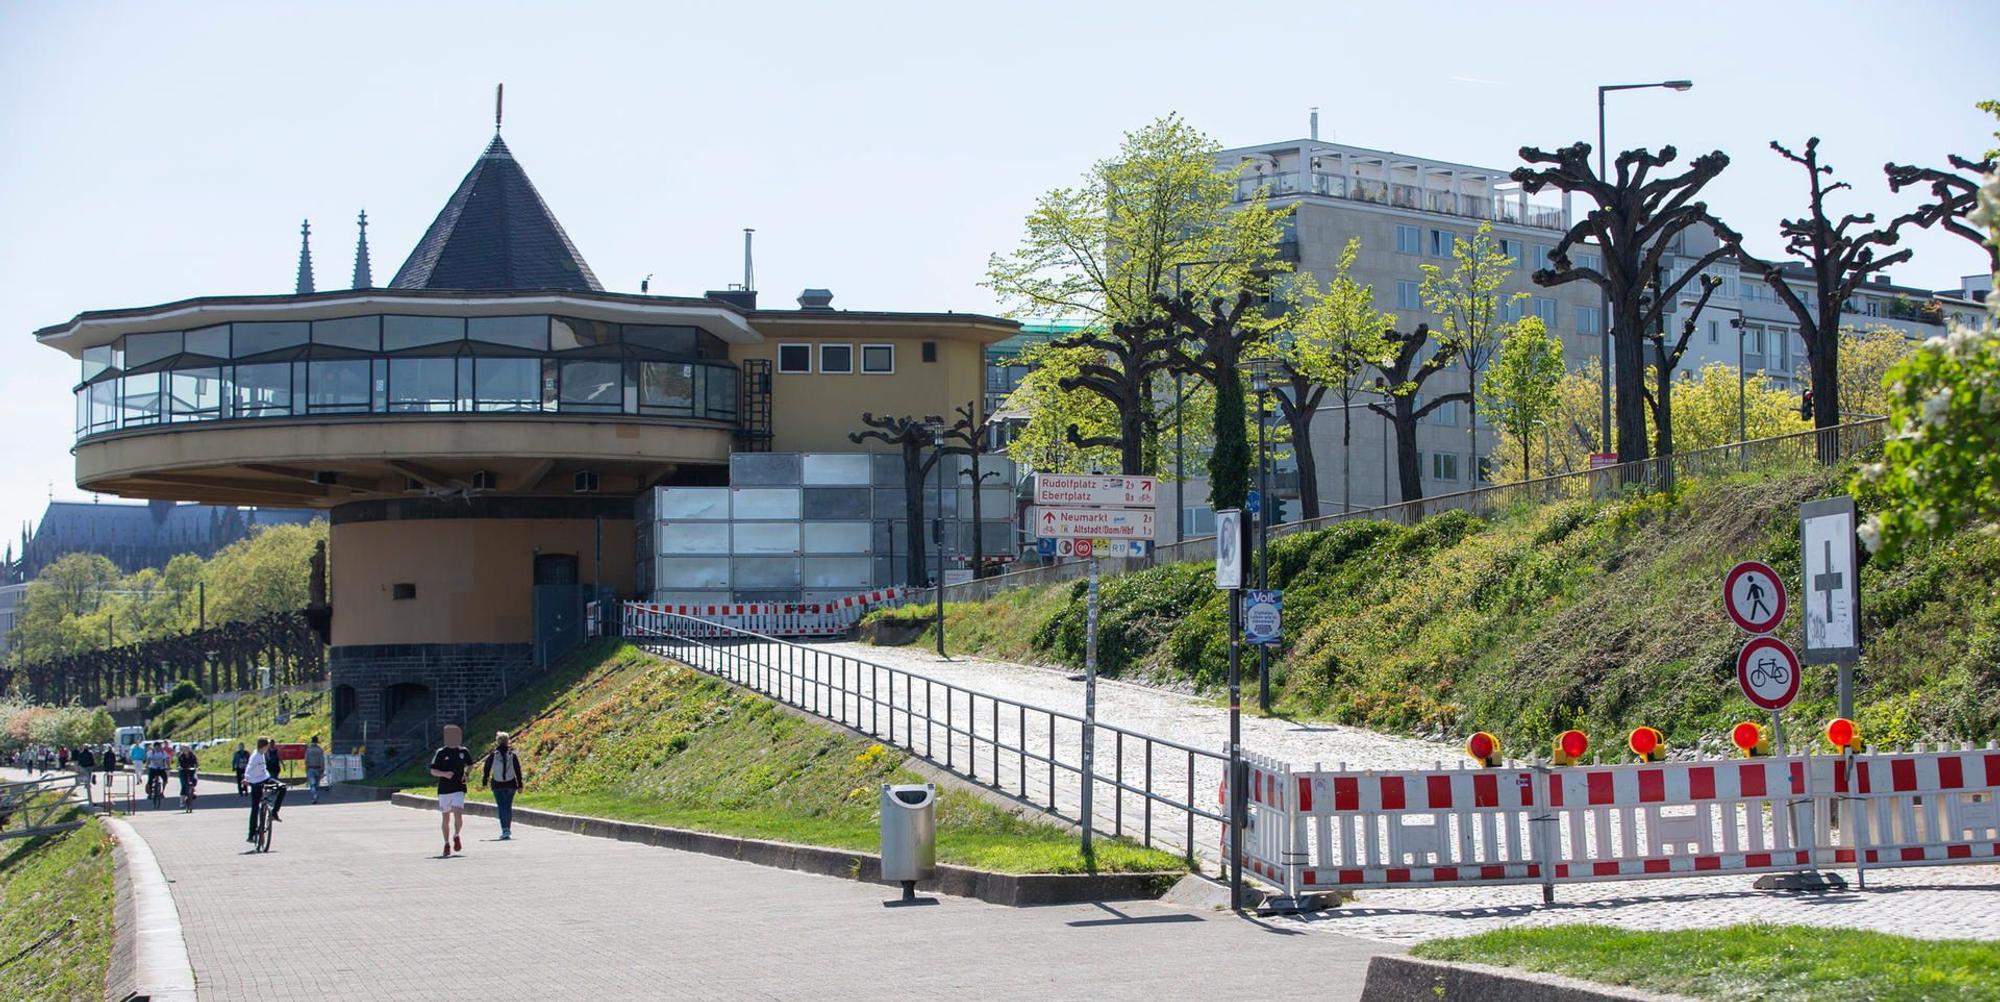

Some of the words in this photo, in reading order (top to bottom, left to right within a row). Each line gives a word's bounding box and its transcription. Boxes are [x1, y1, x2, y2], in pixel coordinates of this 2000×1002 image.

[1042, 479, 1096, 490] Rudolfplatz
[1042, 491, 1091, 502] Ebertplatz
[1060, 512, 1108, 522] Neumarkt
[1252, 591, 1276, 603] Volt
